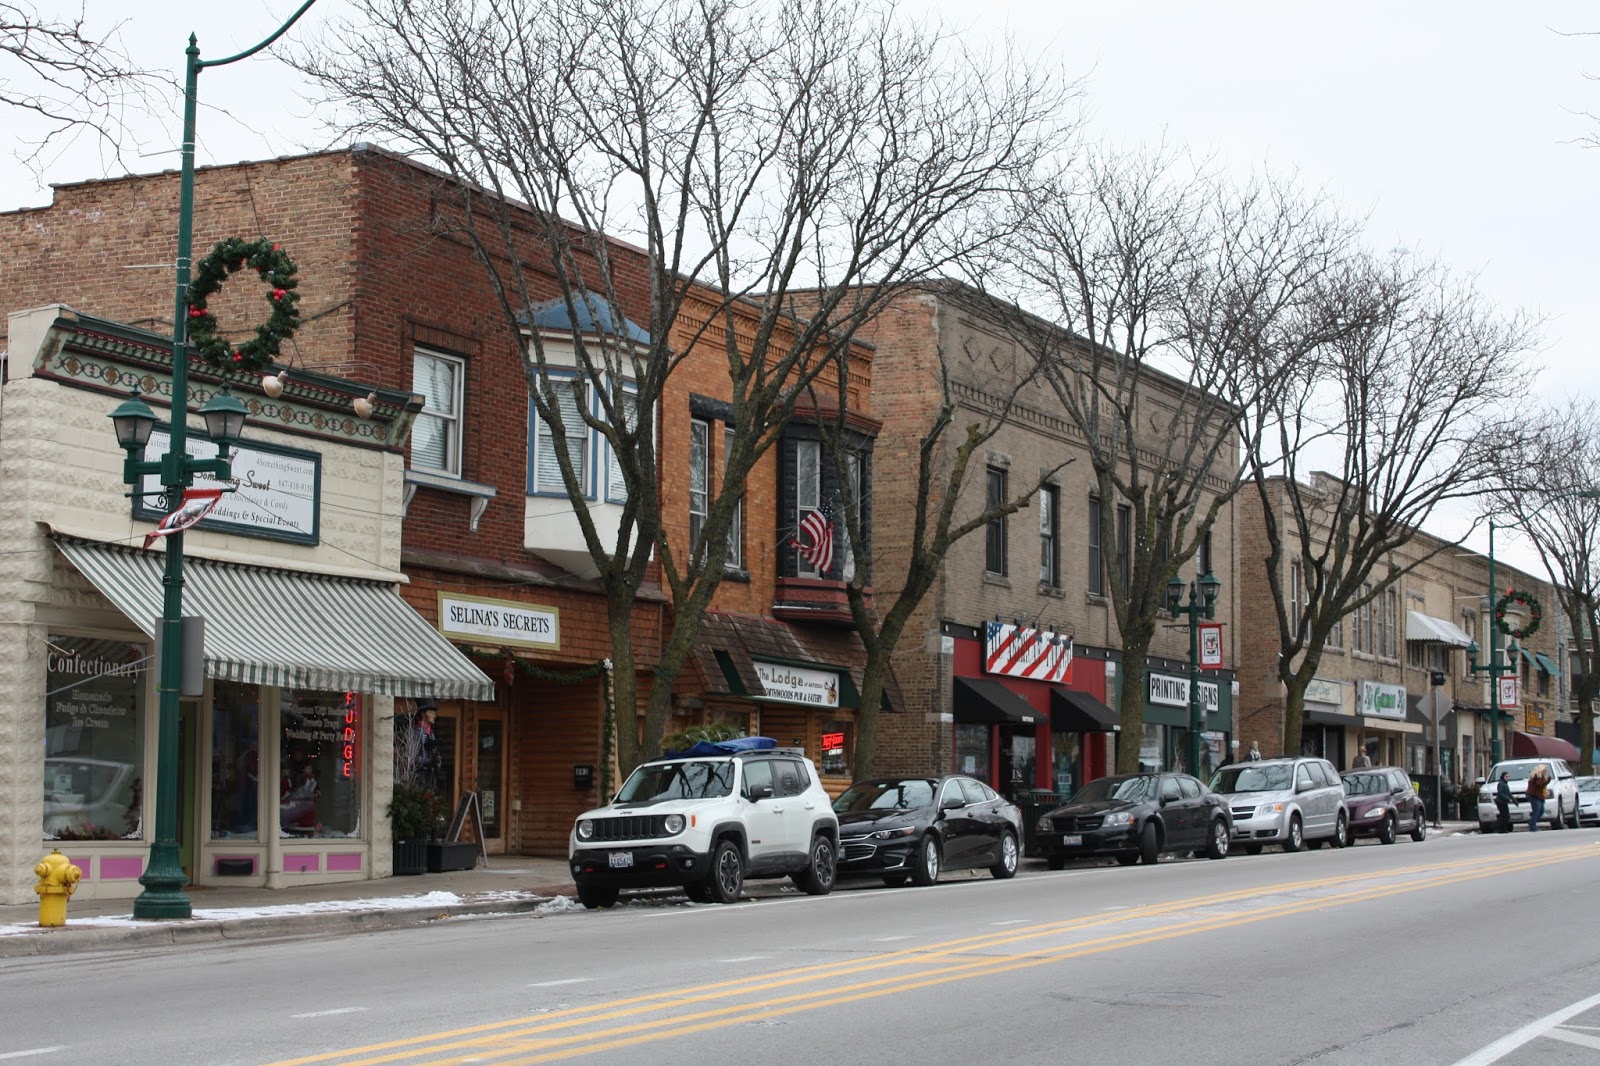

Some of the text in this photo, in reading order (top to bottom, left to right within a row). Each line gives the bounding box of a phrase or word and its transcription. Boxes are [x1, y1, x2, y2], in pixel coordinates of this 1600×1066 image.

[243, 470, 270, 491] Sweet
[242, 510, 248, 519] &
[250, 512, 276, 524] Special
[450, 606, 499, 626] SELINA'S
[503, 612, 550, 633] SECRETS
[47, 652, 138, 683] Confectionery
[759, 668, 770, 680] The
[771, 668, 804, 688] Lodge
[765, 688, 794, 700] ORTHWOODS
[808, 693, 822, 703] EATERY
[1152, 677, 1186, 702] PRINTING
[1198, 684, 1217, 706] SIGNS
[343, 692, 354, 776] FUDGE
[1012, 769, 1022, 779] 18
